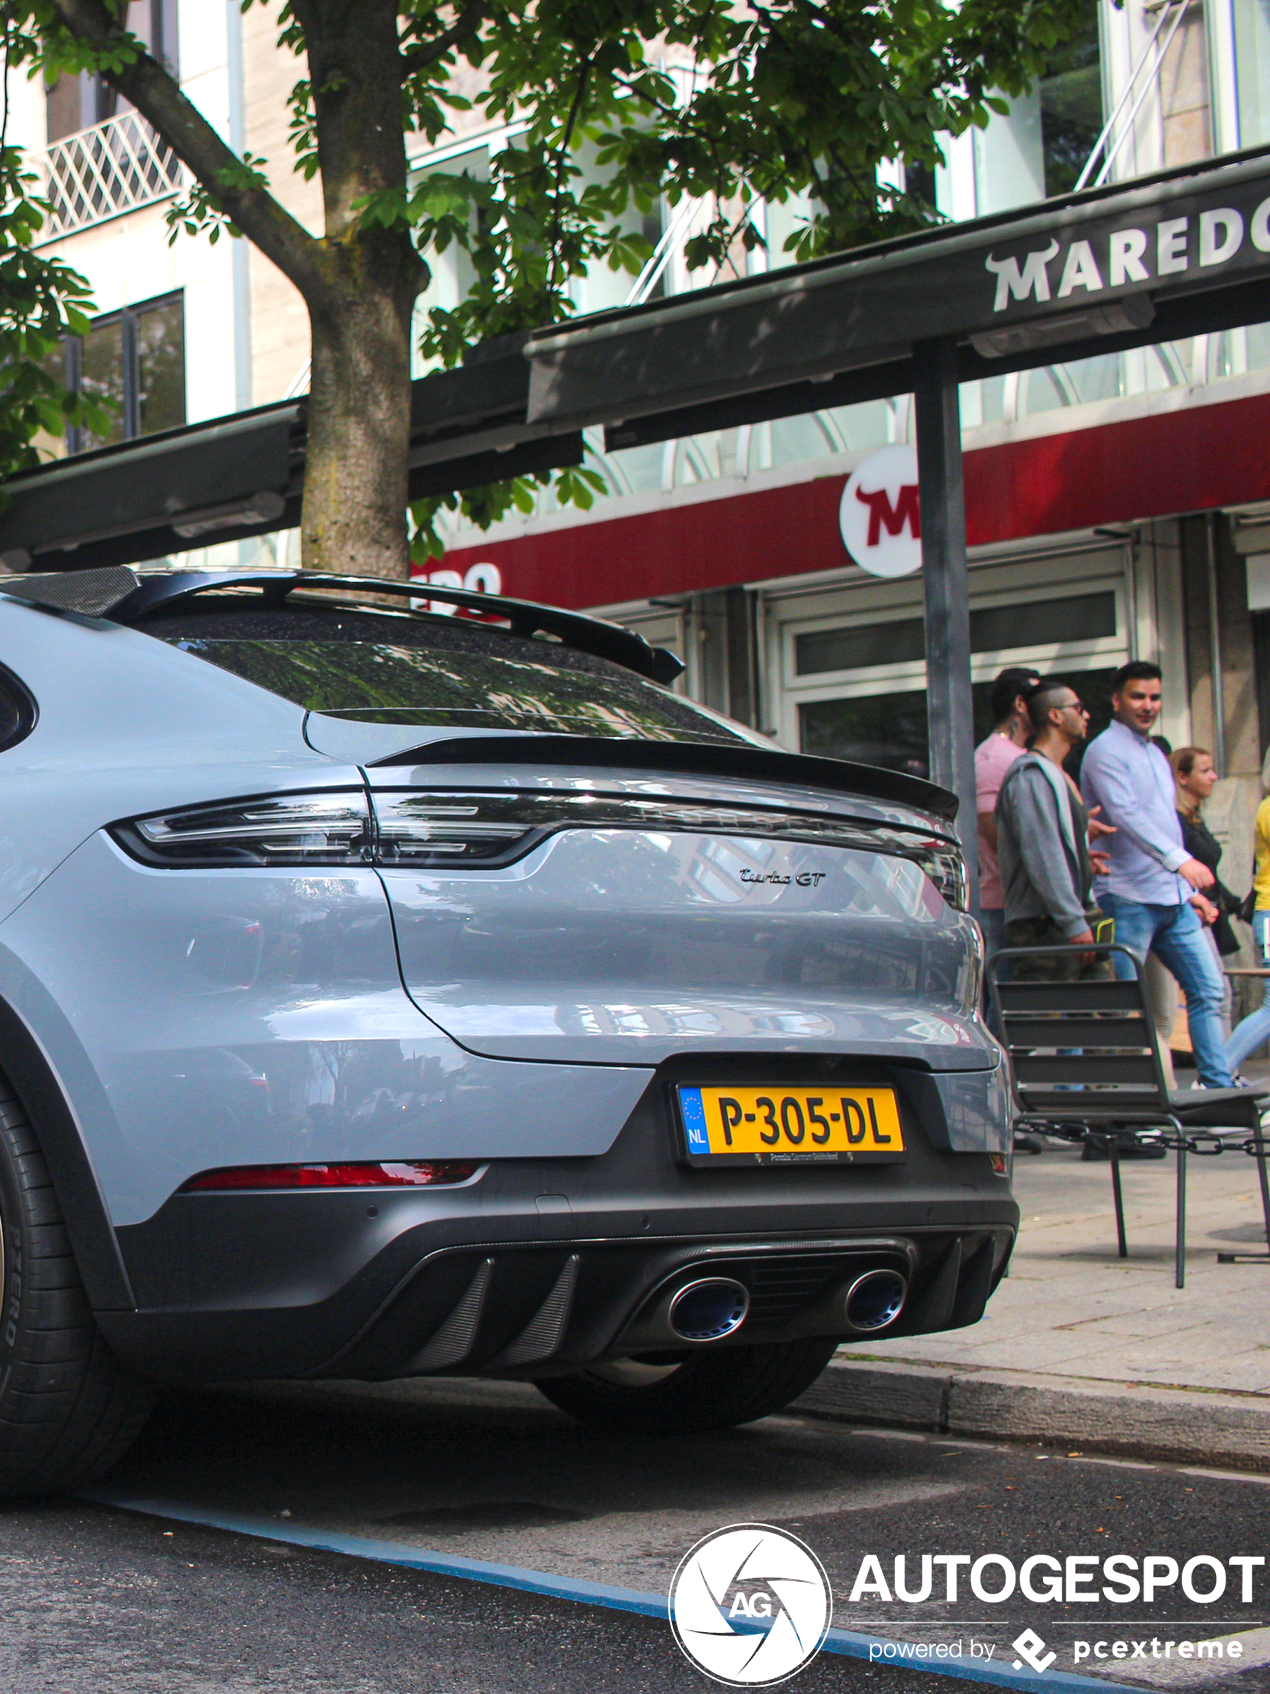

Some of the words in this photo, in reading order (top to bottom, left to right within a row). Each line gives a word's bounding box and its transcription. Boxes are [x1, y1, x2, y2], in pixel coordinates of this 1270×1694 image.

[739, 867, 792, 885] Turbo
[795, 872, 826, 887] GT
[718, 1096, 892, 1146] P-305-DL
[688, 1128, 706, 1144] NL
